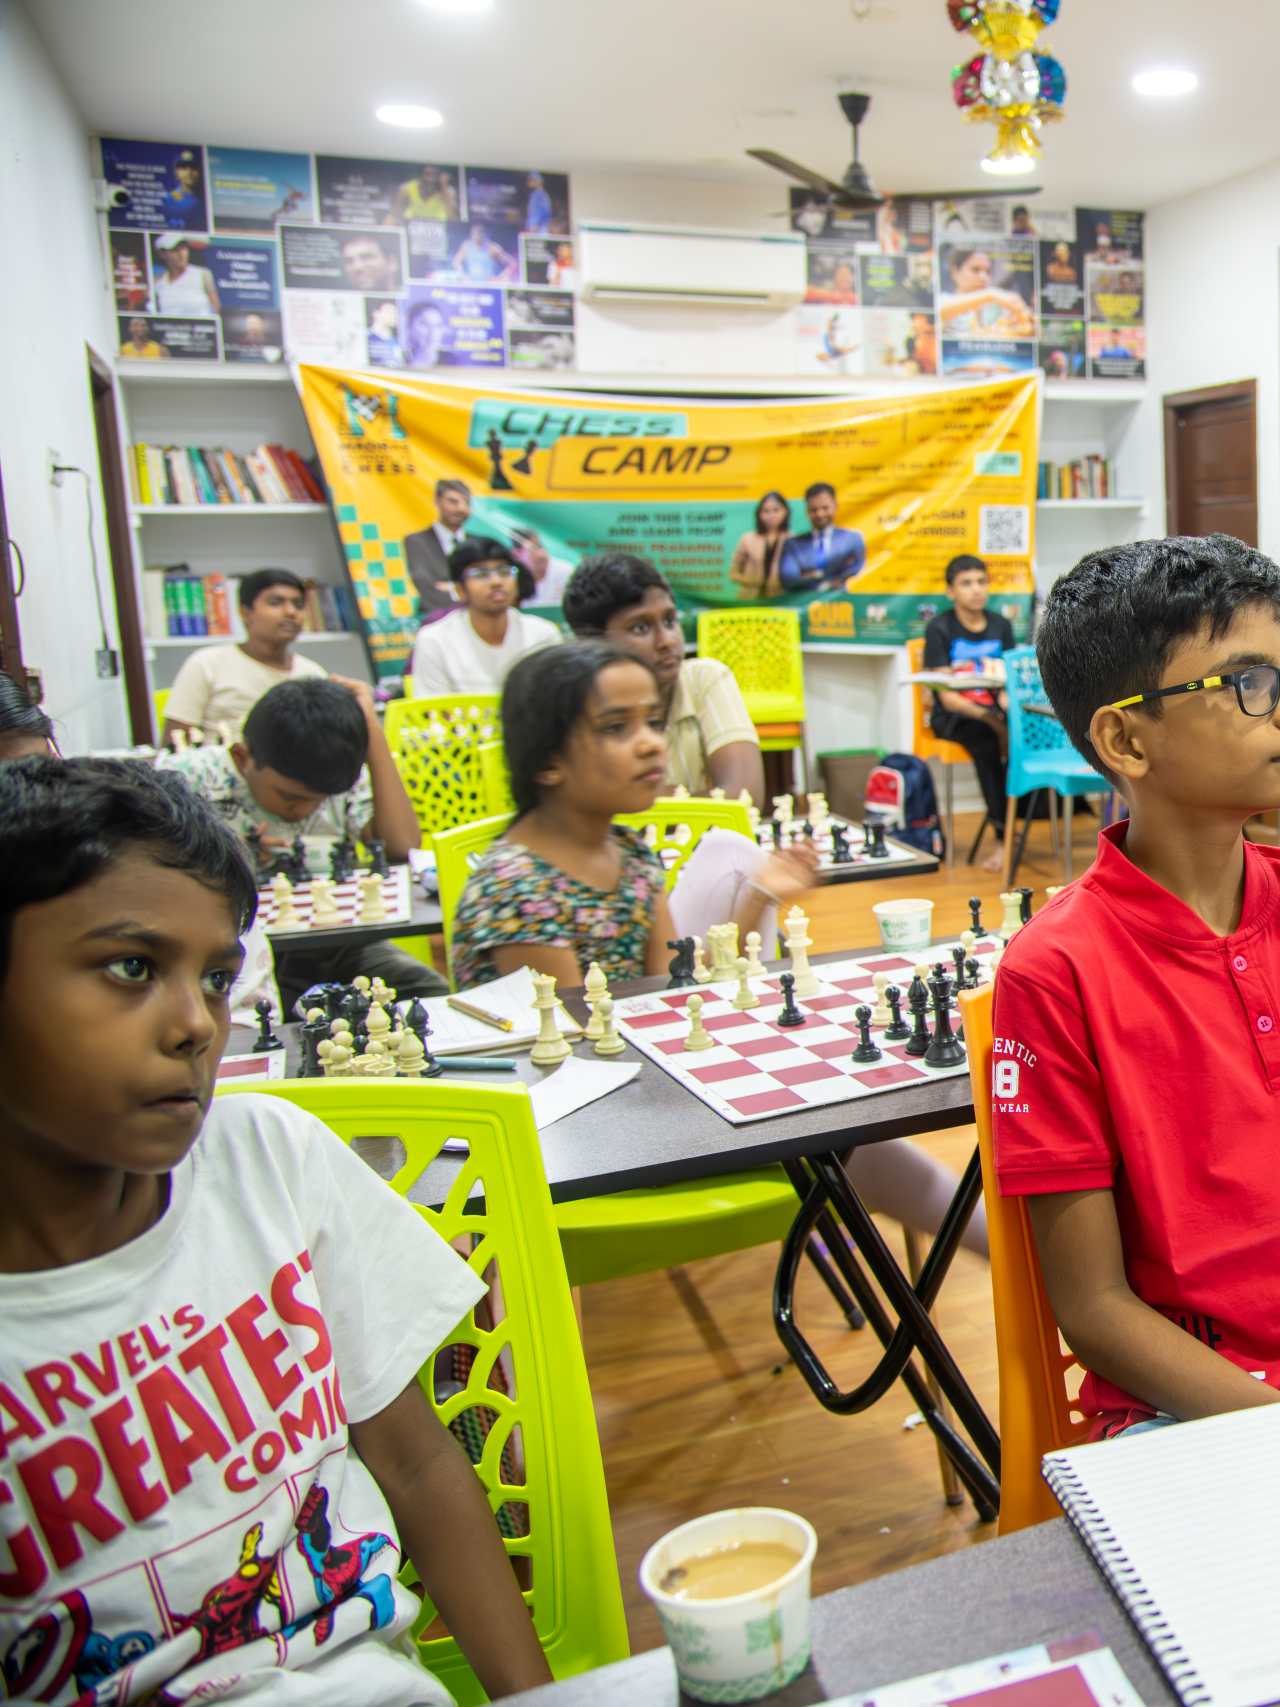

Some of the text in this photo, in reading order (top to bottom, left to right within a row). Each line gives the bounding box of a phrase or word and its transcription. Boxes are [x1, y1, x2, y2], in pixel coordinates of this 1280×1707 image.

[502, 406, 677, 438] CHESS
[580, 444, 734, 475] CAMP
[608, 526, 726, 538] AND LEARN FROM
[617, 511, 726, 524] JOIN THE CAMP
[807, 600, 855, 627] OUR
[993, 1037, 1037, 1068] ENTIC
[993, 1060, 1020, 1099] 8
[999, 1103, 1030, 1114] WEAR
[0, 1303, 206, 1460] ARVEL'S
[0, 1248, 333, 1600] GREATES
